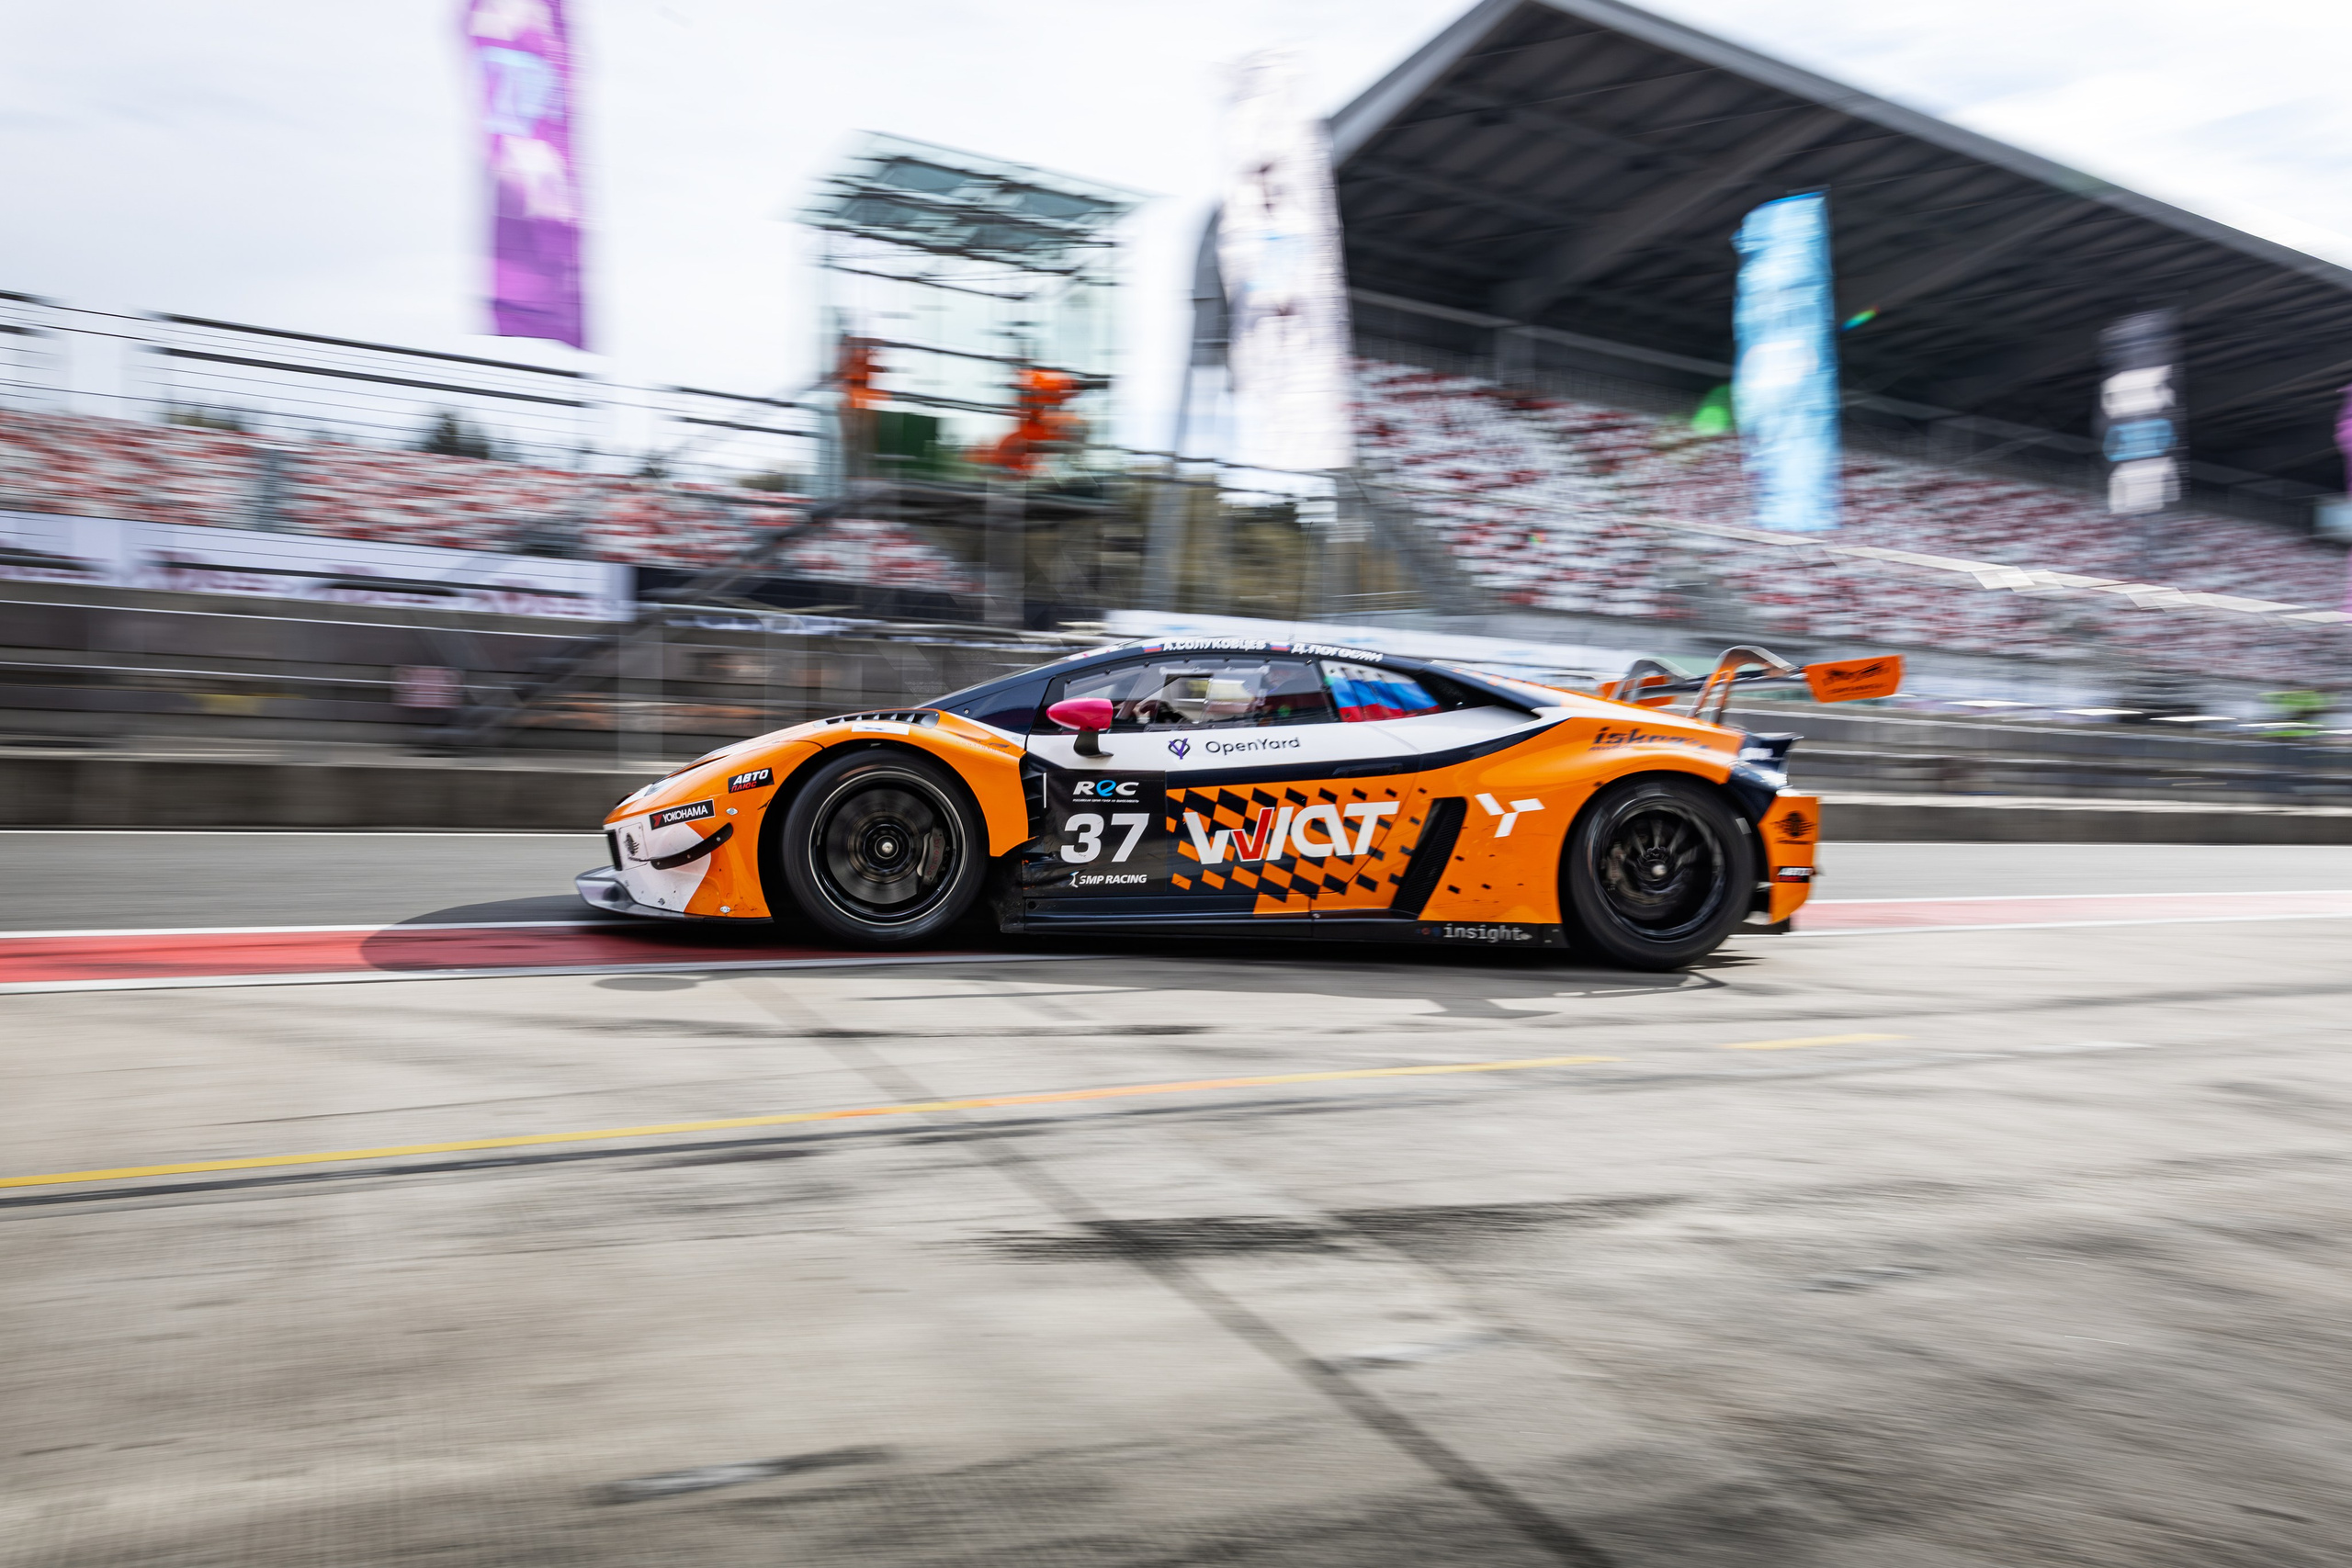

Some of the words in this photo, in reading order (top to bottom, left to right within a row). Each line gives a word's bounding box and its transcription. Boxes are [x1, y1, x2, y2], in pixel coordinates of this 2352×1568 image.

[1205, 737, 1301, 756] OpenYard
[733, 769, 769, 785] АВТО
[730, 781, 757, 792] ПЛЮС
[662, 805, 708, 823] YOKOHAMA
[1060, 812, 1150, 864] 37
[1079, 875, 1104, 885] SMP
[1105, 874, 1148, 884] RACING
[1443, 923, 1523, 943] insight
